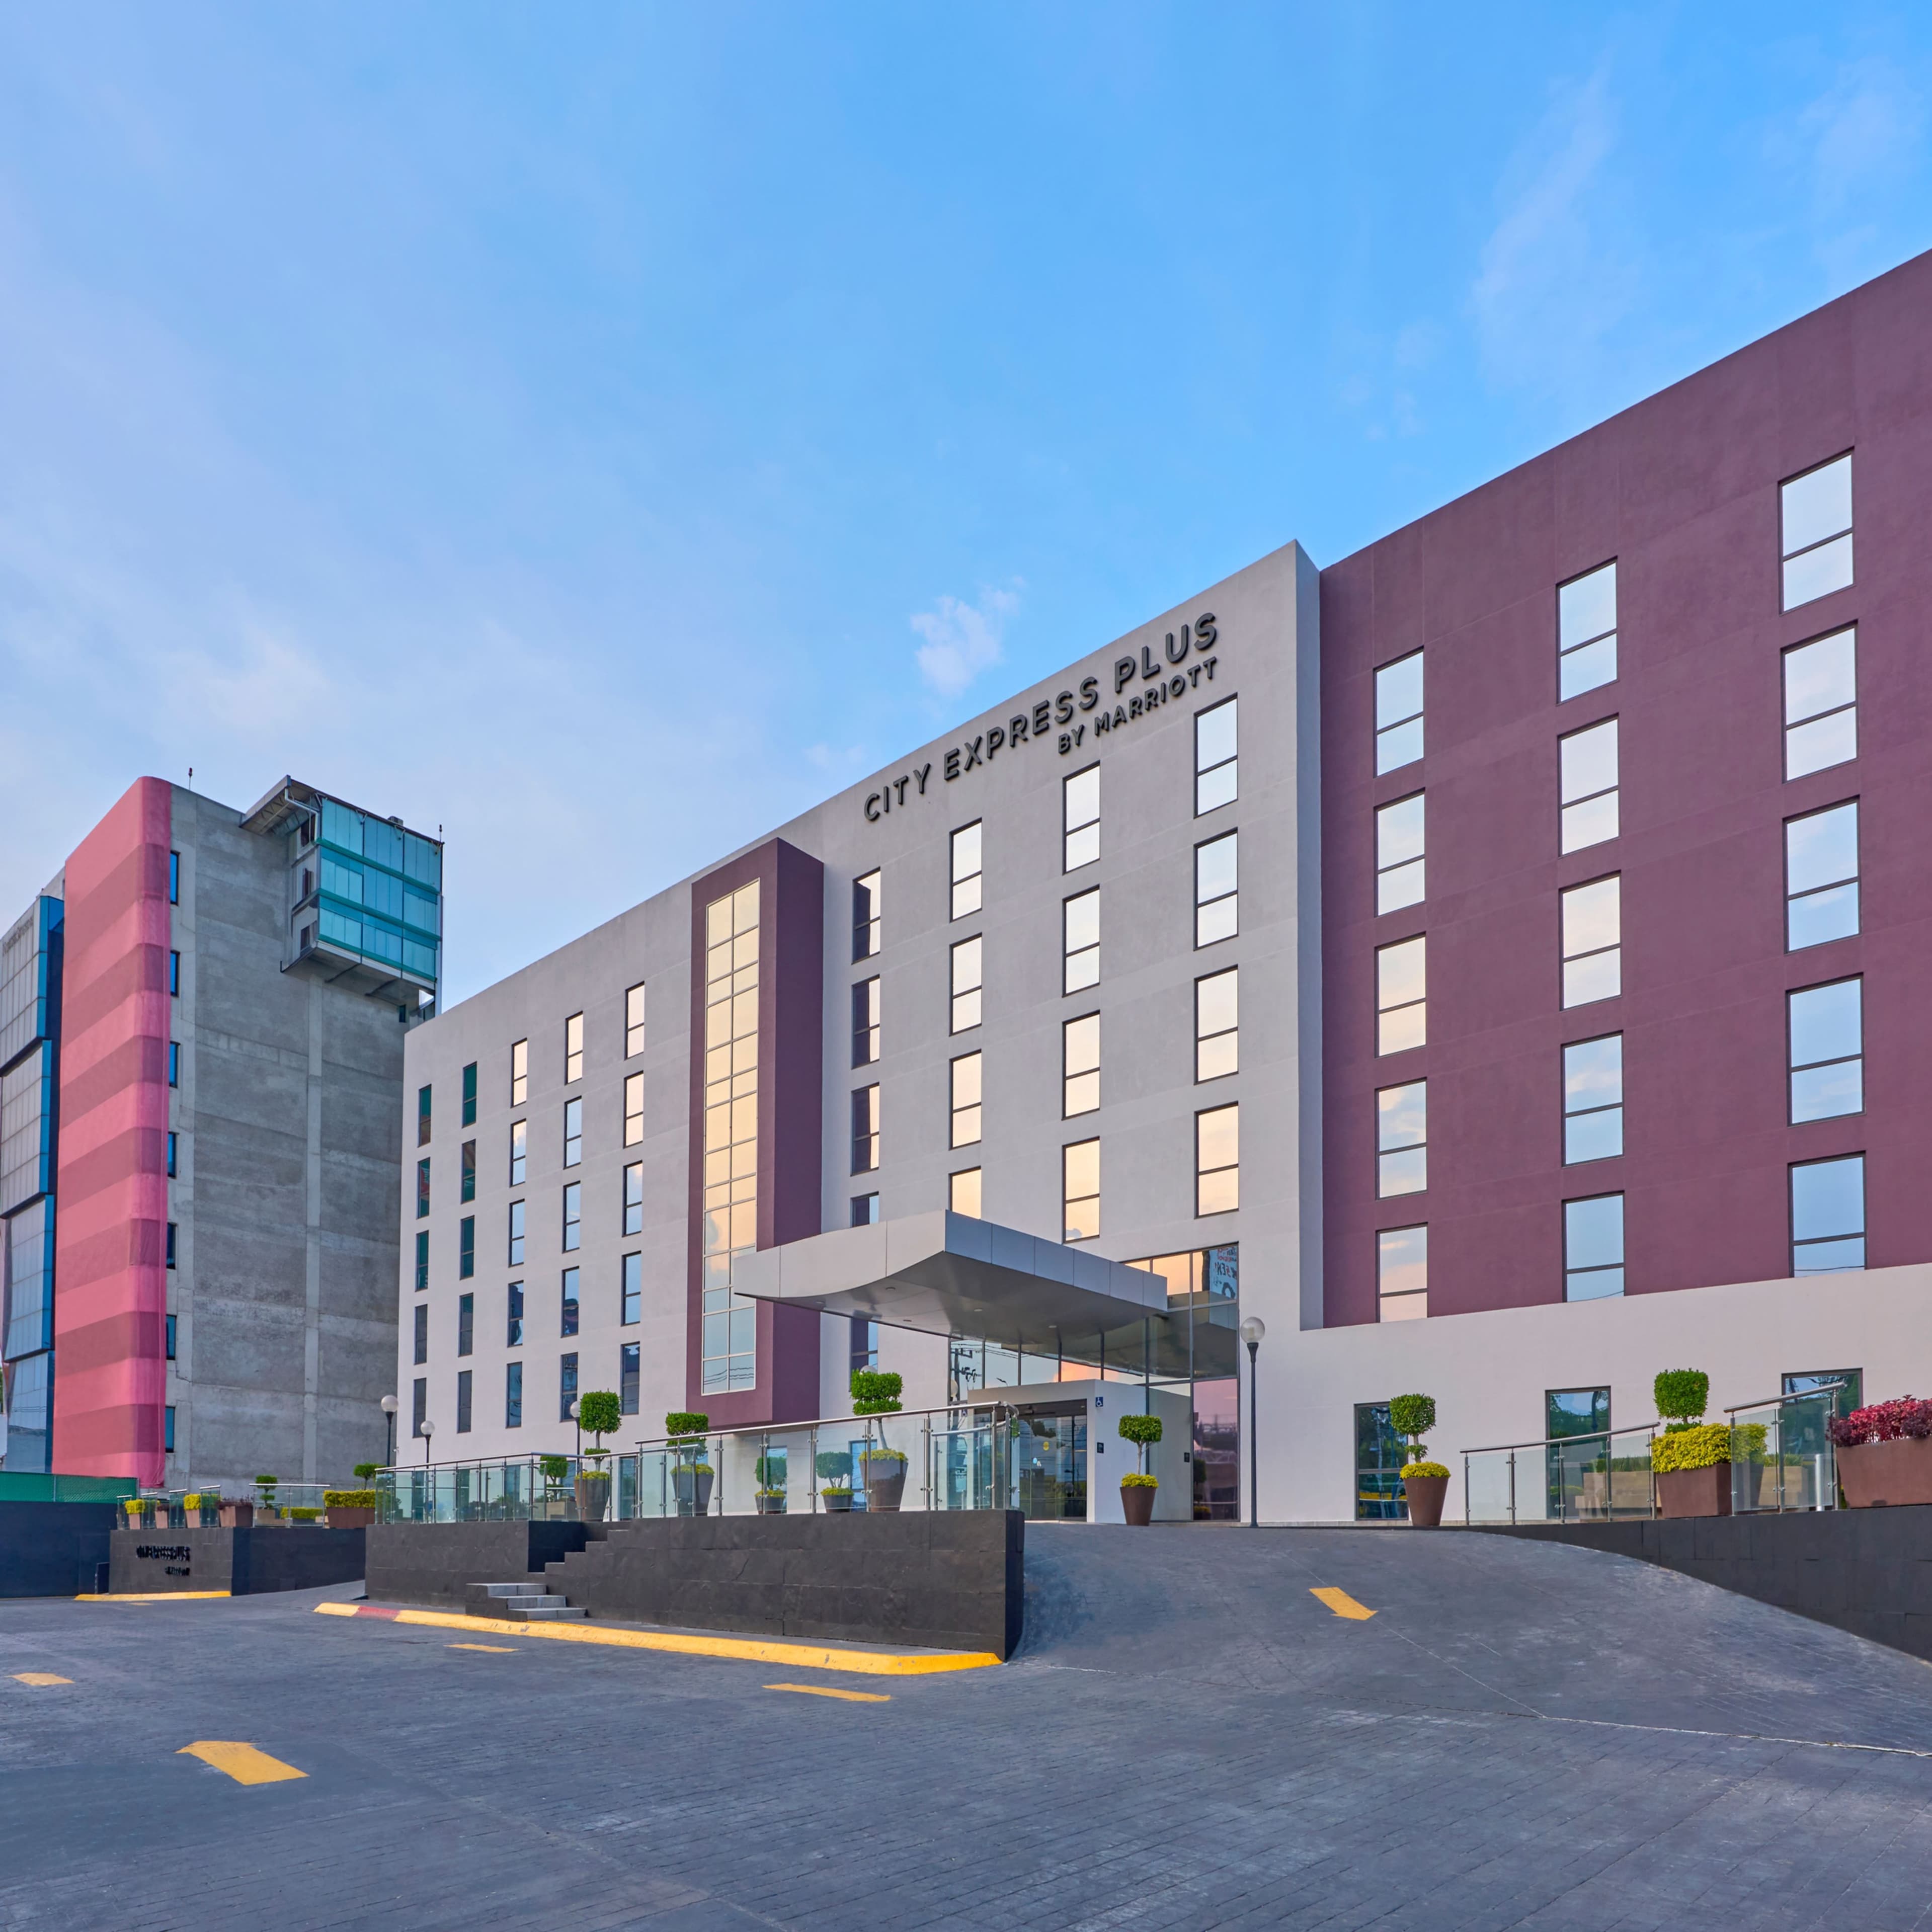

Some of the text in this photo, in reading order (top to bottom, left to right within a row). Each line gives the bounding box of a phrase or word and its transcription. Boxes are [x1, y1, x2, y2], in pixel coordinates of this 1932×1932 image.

[863, 612, 1217, 822] CITY EXPRESS PLUS
[1058, 656, 1217, 755] BY MARRIOTT
